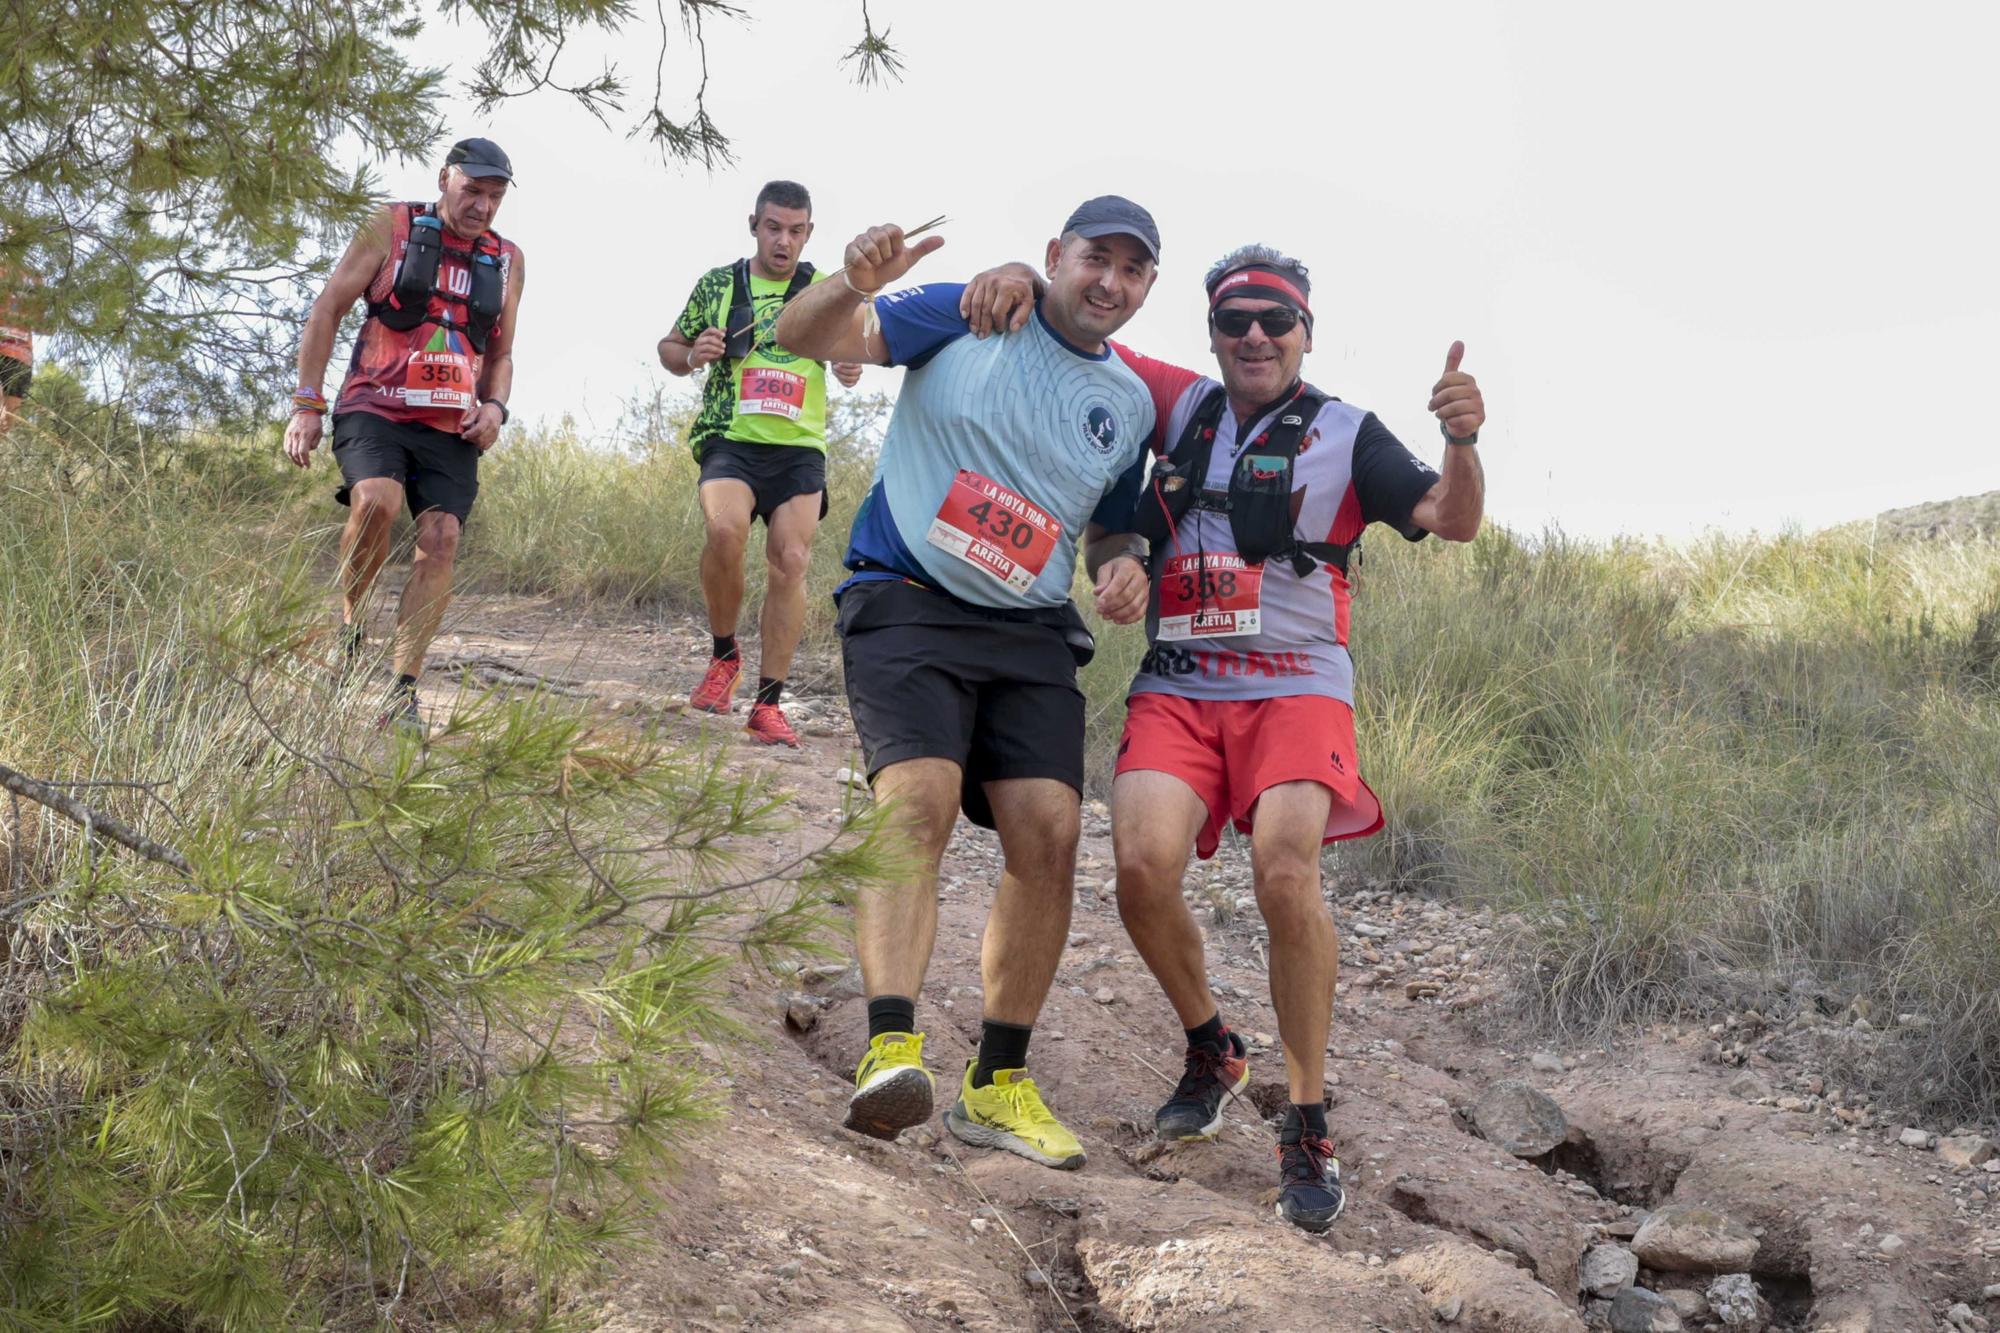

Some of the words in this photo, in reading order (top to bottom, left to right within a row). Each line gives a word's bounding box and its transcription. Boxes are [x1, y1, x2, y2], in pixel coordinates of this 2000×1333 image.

[424, 353, 434, 363] LA
[421, 364, 462, 383] 350
[758, 369, 767, 378] LA
[432, 391, 461, 401] ARETIA
[754, 378, 793, 397] 260
[983, 483, 998, 499] LA
[997, 491, 1025, 516] HOYA
[1024, 506, 1048, 531] TRAIL
[967, 500, 1034, 550] 430
[970, 542, 1011, 574] ARETIA
[1182, 559, 1193, 571] LA
[1193, 555, 1219, 570] HYA
[1221, 556, 1248, 570] TRAIL
[1193, 614, 1233, 628] ARETIA
